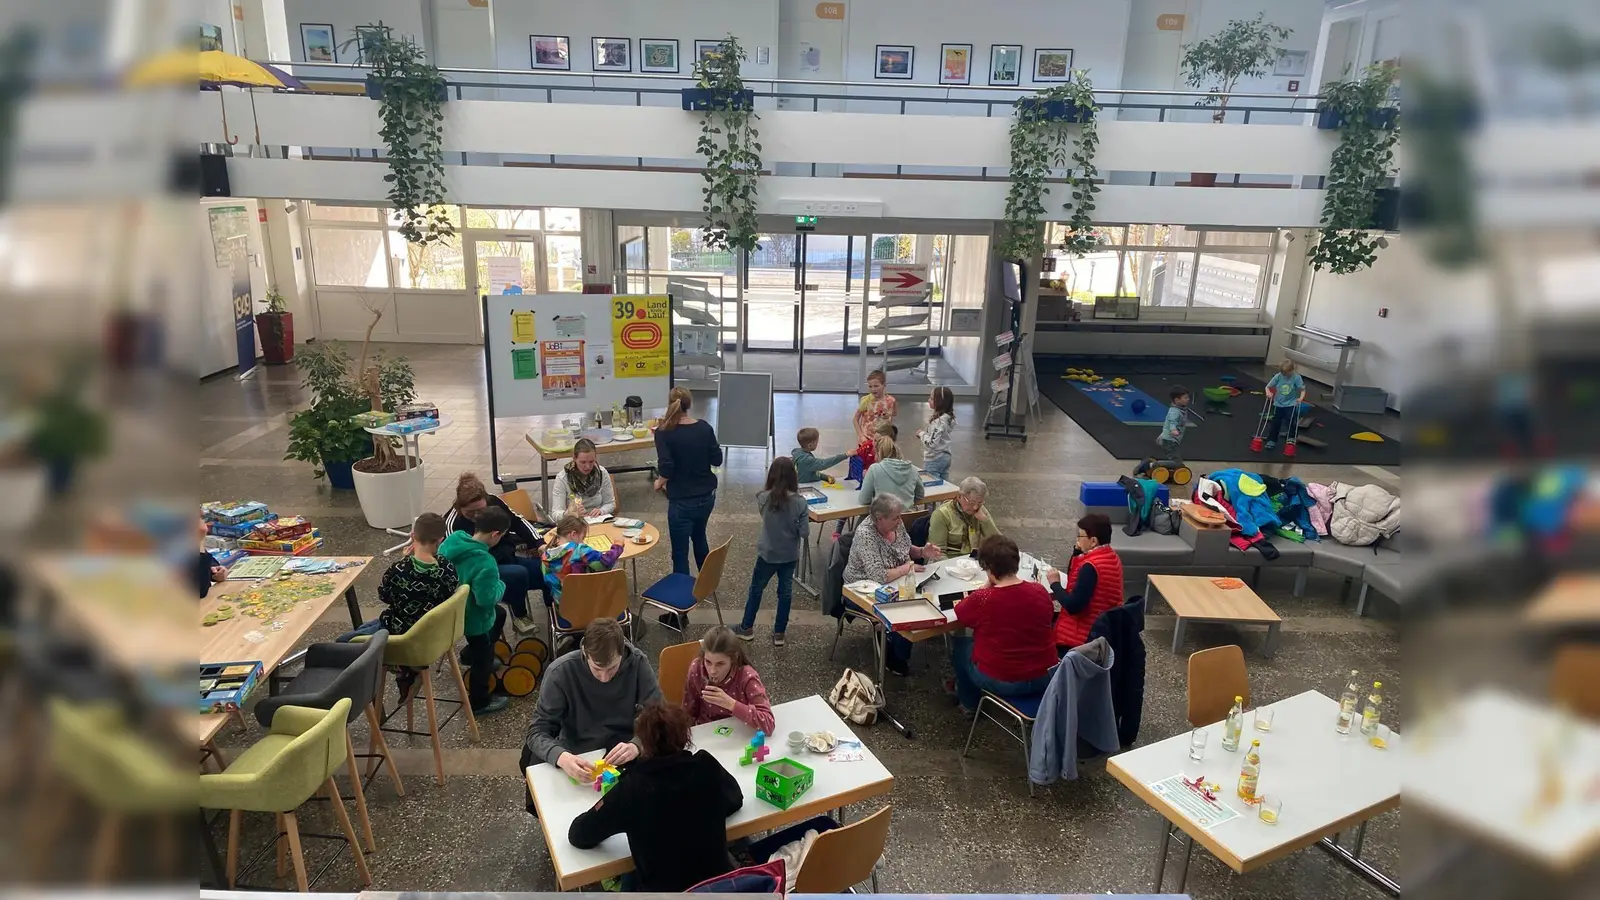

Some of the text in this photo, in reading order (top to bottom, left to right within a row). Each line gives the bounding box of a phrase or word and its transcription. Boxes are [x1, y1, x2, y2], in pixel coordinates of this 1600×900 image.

[647, 301, 667, 309] Land
[614, 301, 635, 320] 39
[648, 310, 665, 319] Lauf
